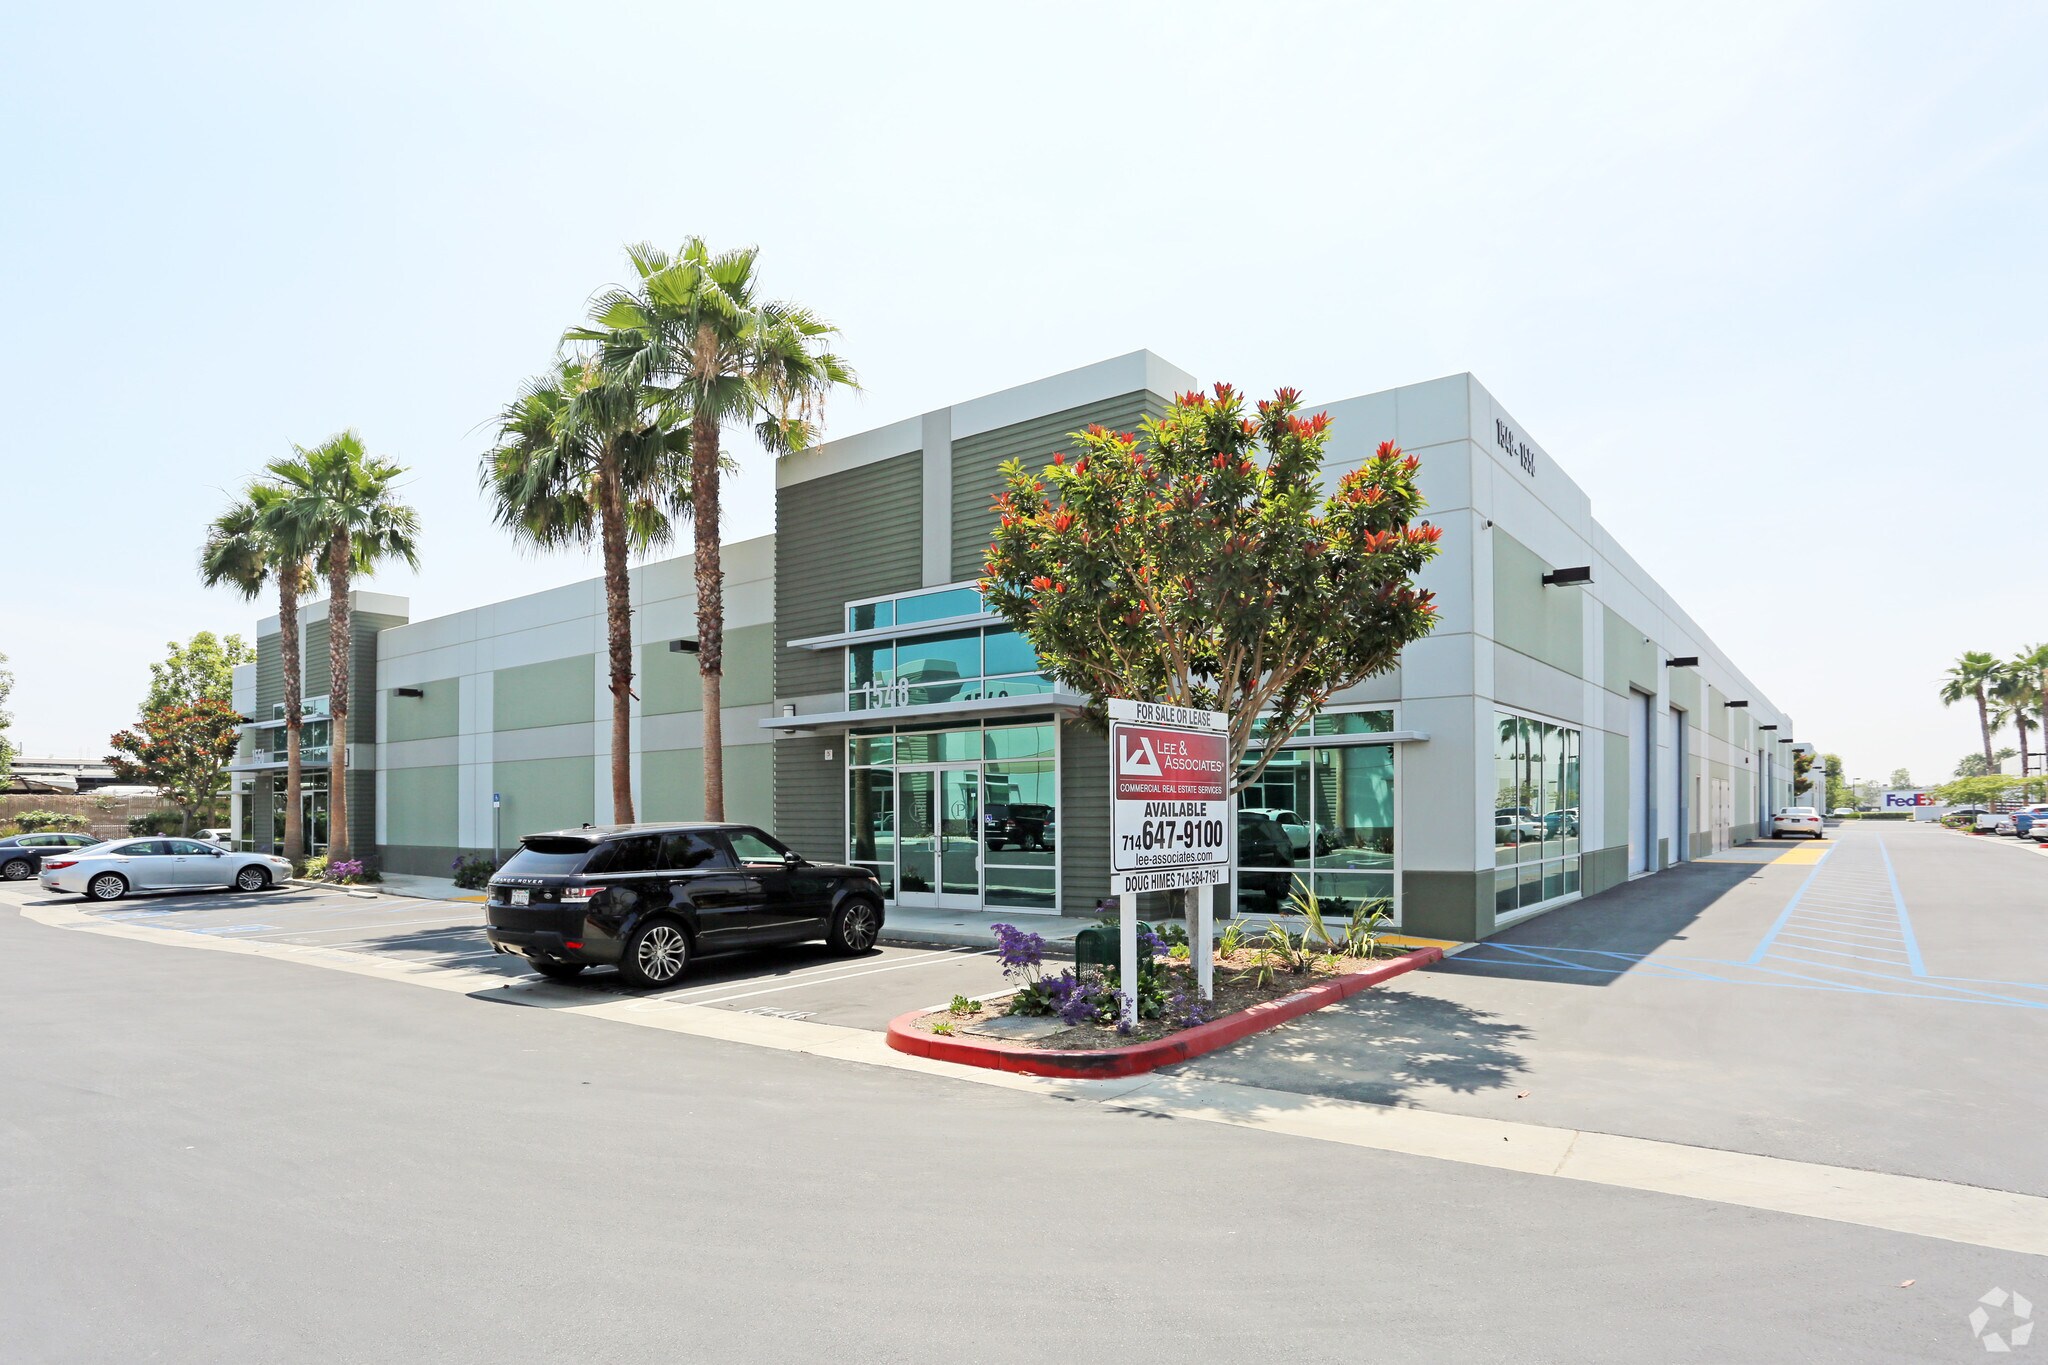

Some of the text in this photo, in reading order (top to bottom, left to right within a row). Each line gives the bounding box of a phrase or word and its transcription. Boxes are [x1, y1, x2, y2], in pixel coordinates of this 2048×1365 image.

[862, 677, 909, 711] 1548
[1136, 703, 1211, 727] FOR SALE OR LEASE
[1178, 740, 1188, 756] &
[1119, 783, 1161, 793] COMMERCIAL
[1162, 785, 1176, 793] REAL
[1177, 786, 1197, 794] ESTATE
[1144, 802, 1207, 818] AVAILABLE
[1122, 819, 1223, 851] 714 647-9100
[1135, 850, 1213, 866] lee-associates.com
[1125, 869, 1219, 893] DOUG HIMES 714-564-7191
